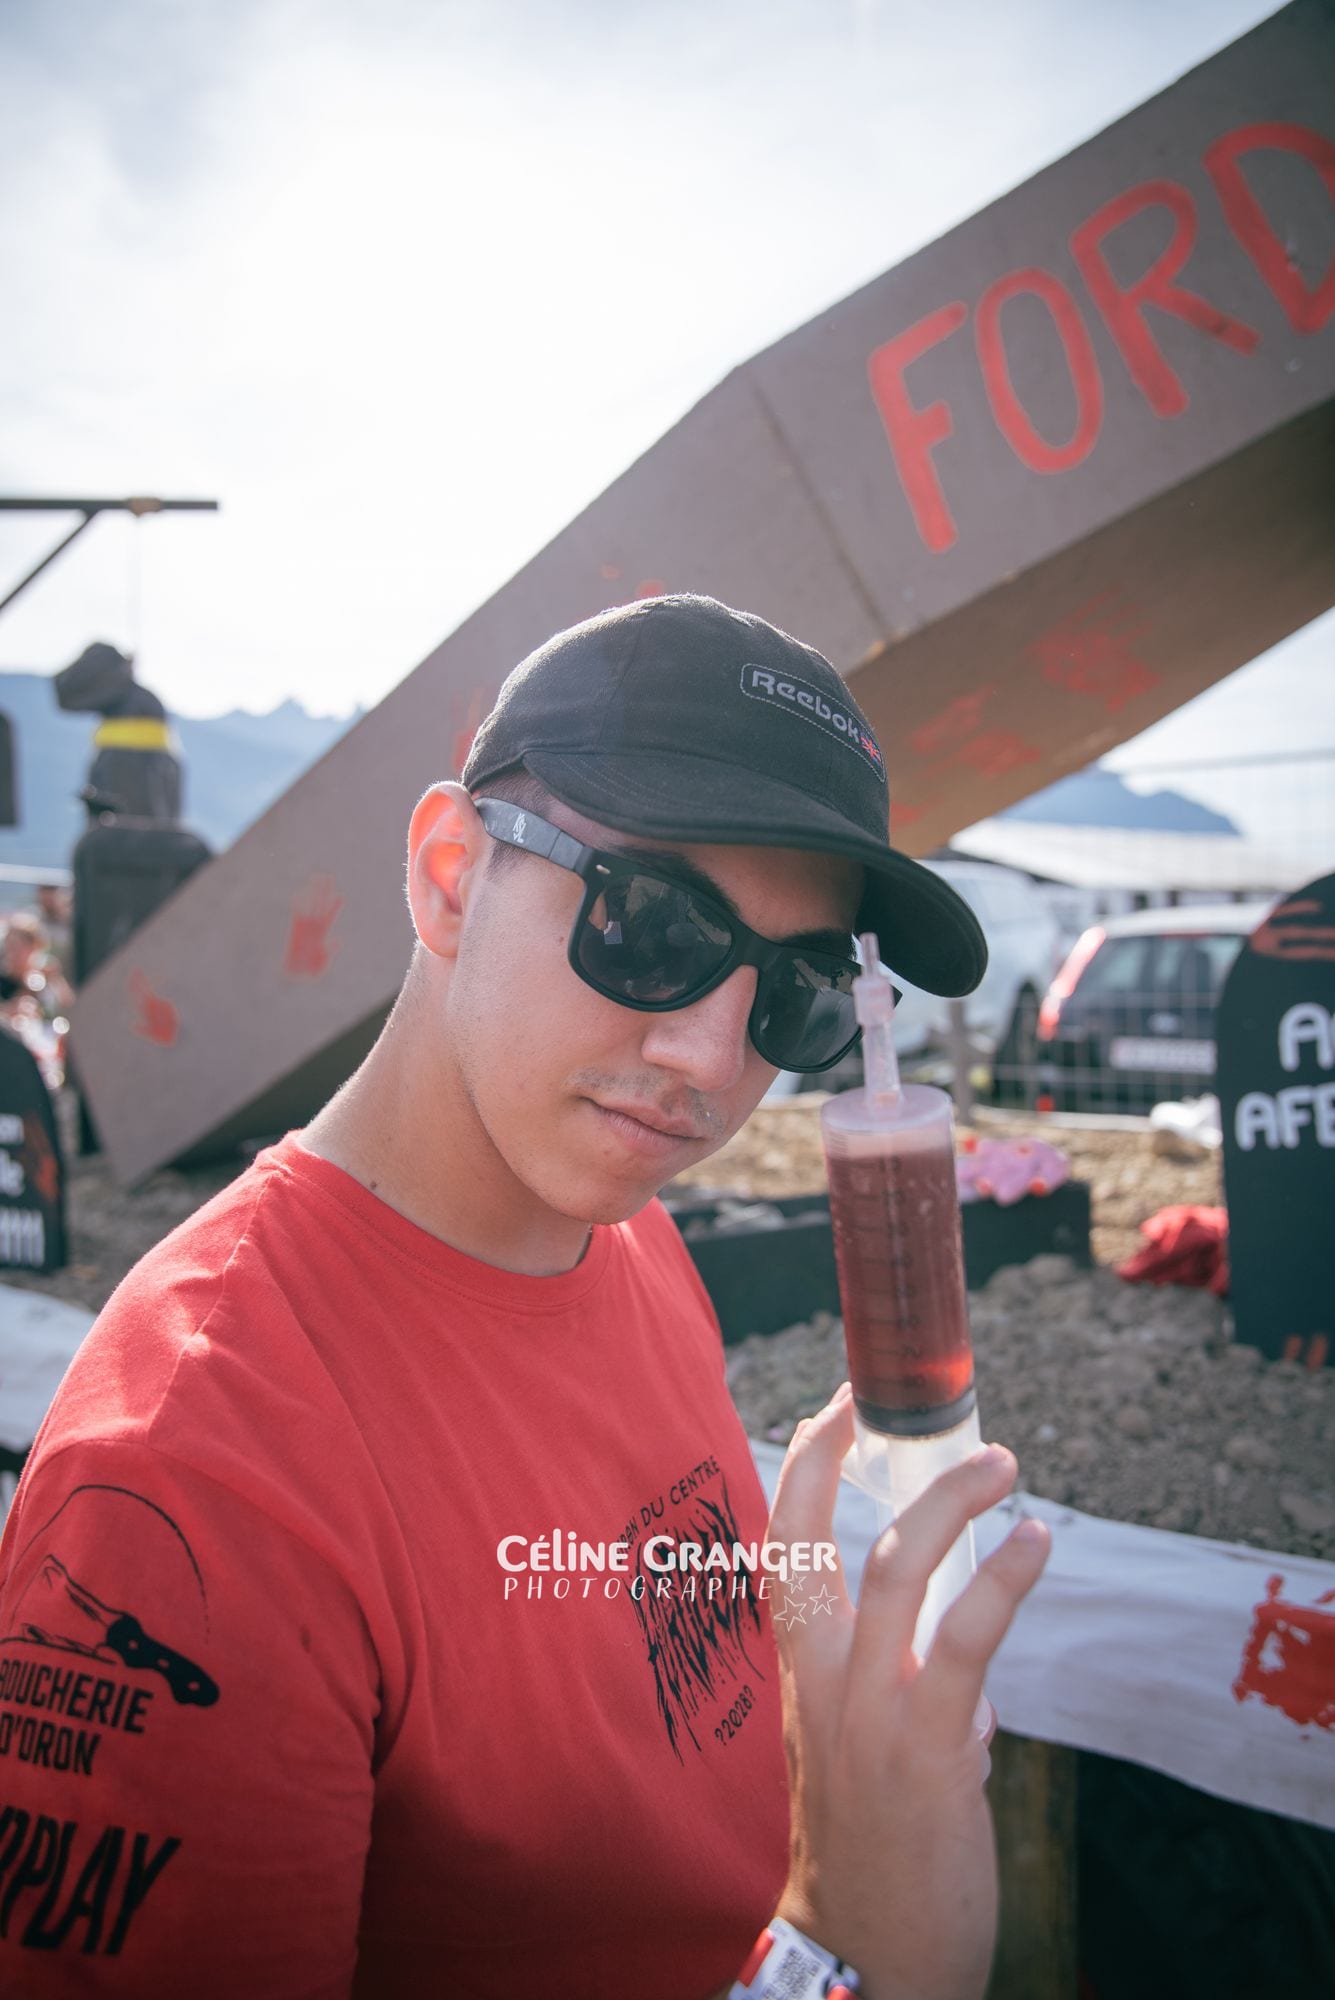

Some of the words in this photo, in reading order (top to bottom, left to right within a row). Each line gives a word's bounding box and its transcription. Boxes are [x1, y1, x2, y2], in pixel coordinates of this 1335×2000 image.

[867, 121, 1335, 554] FORD
[752, 670, 860, 743] Reebok
[1278, 1002, 1335, 1072] A
[640, 1496, 665, 1529] DU
[669, 1455, 720, 1505] CENTRE
[0, 1711, 101, 1776] D'ORON
